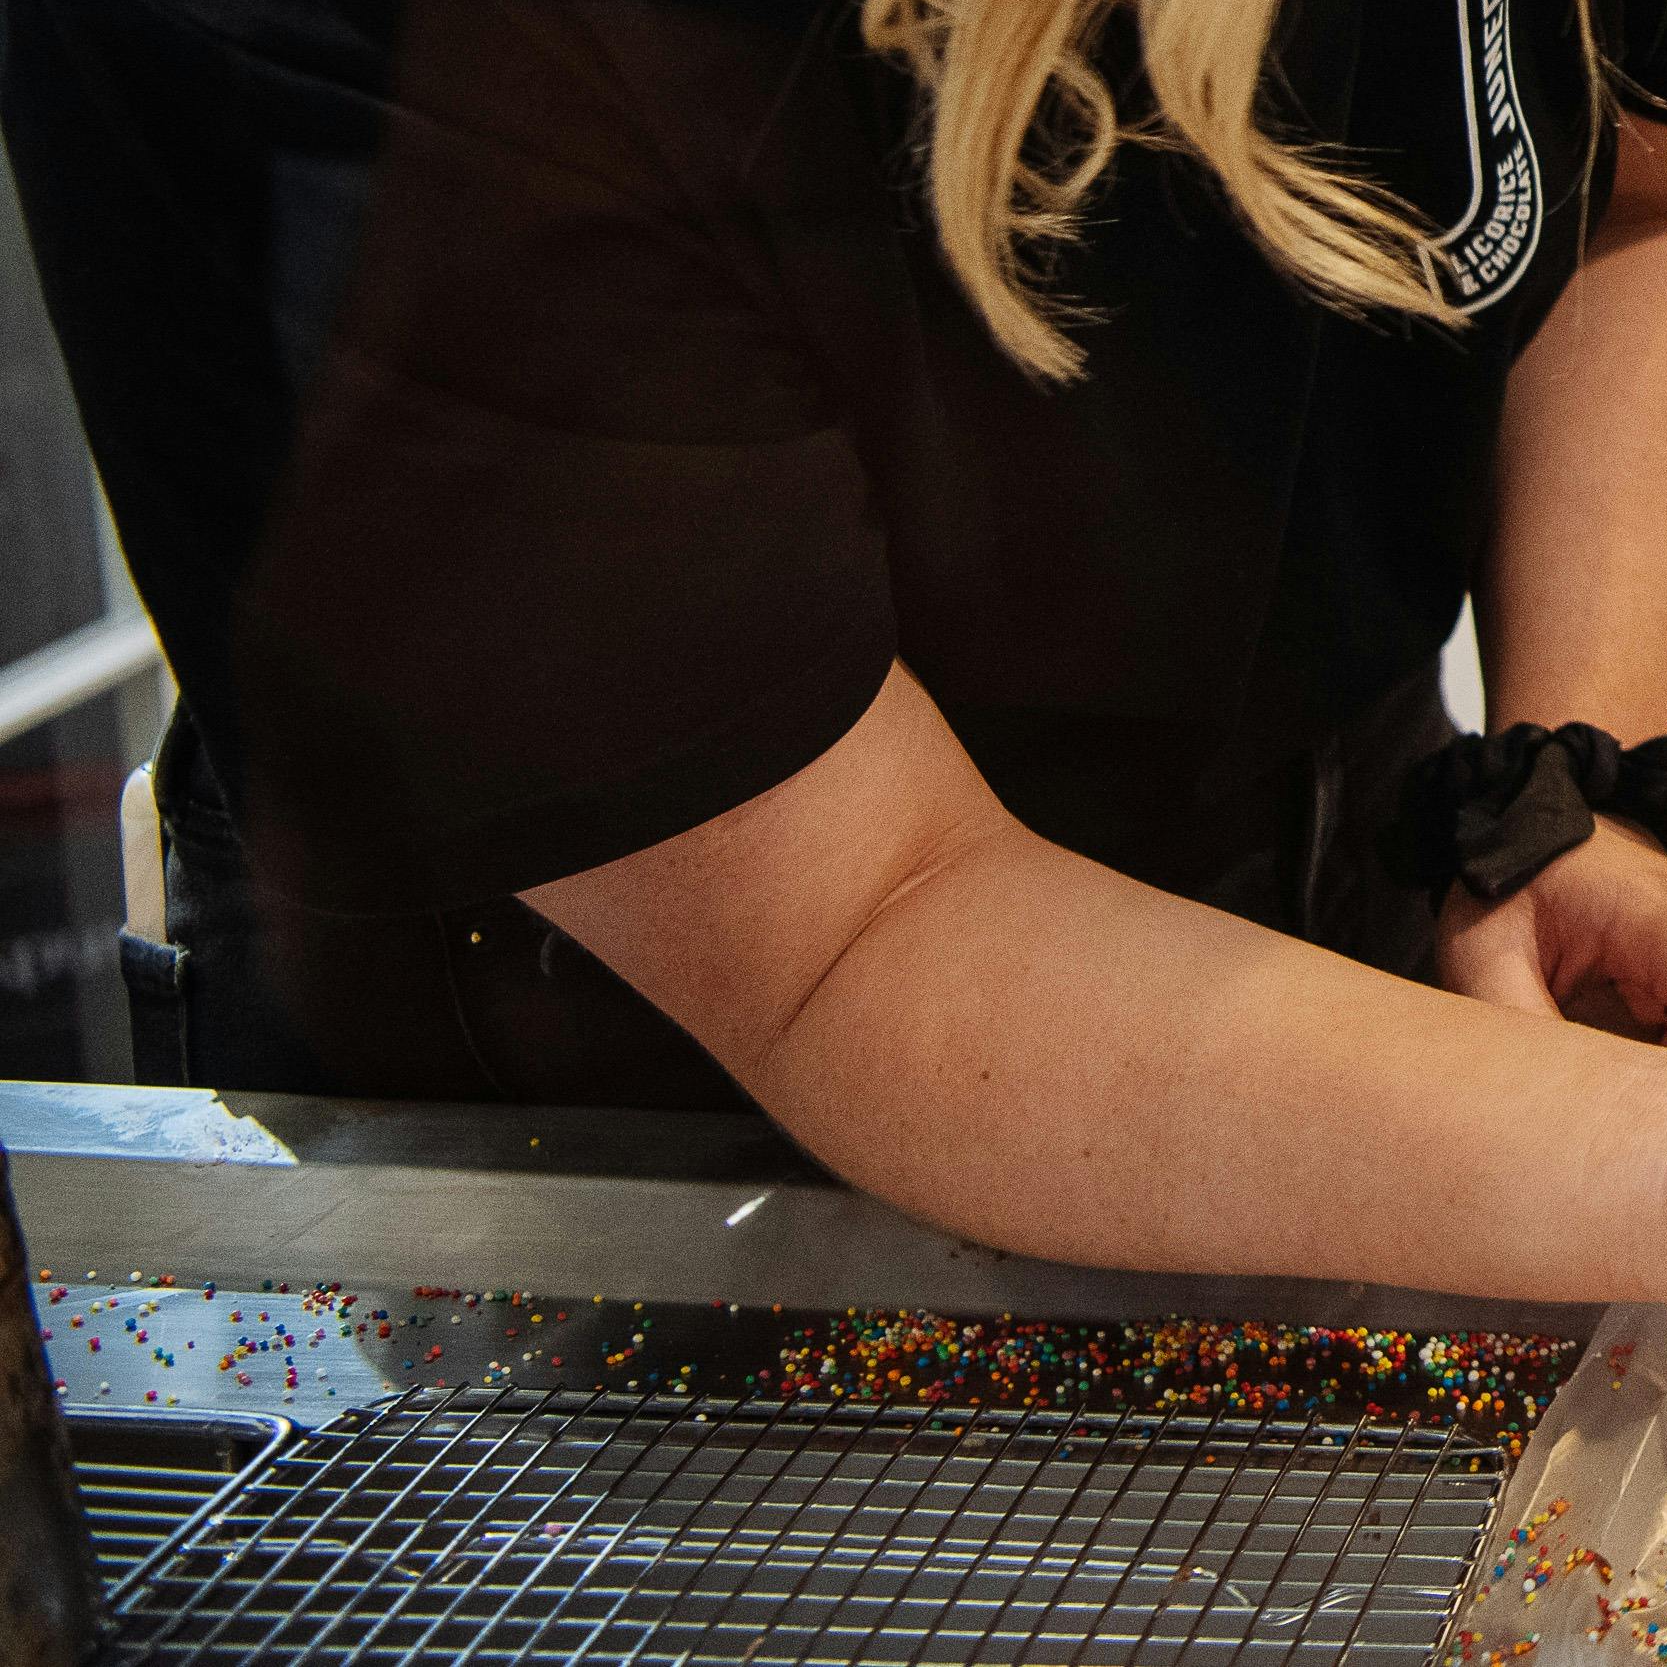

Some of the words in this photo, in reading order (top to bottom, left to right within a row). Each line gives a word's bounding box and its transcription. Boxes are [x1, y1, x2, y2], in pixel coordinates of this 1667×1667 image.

[1451, 153, 1516, 274] LICORICE
[1461, 272, 1481, 296] &
[1479, 139, 1532, 283] CHOCOLATE
